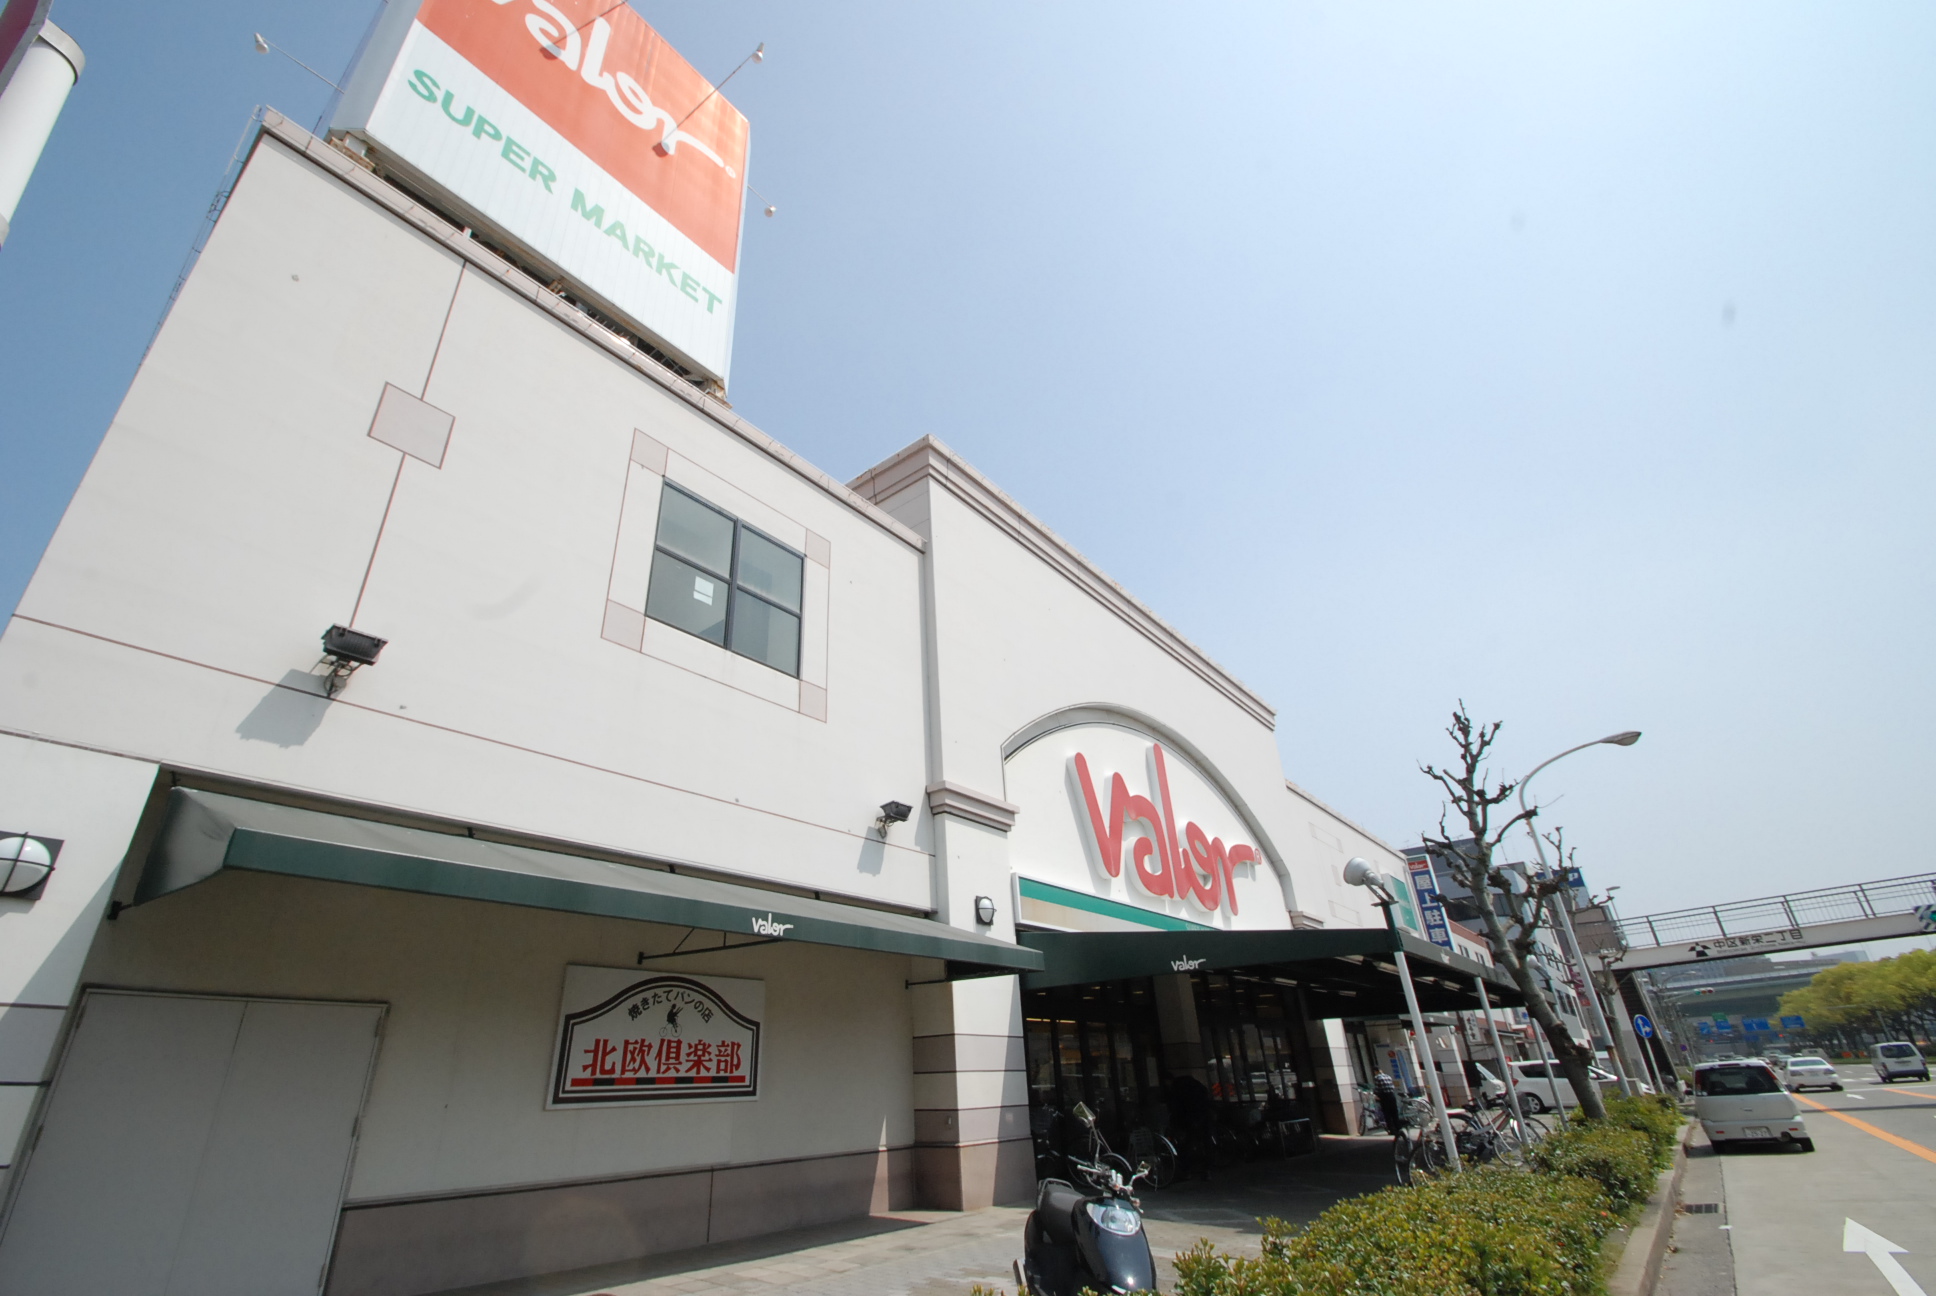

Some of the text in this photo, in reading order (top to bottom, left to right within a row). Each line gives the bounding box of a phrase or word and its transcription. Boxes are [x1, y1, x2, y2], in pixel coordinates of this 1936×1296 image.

[491, 0, 726, 168] alor
[407, 69, 723, 314] SUPER MARKET
[1414, 874, 1450, 951] 屋上駐車
[1713, 928, 1803, 949] 中区新栄二丁目
[627, 989, 714, 1023] 焼きたてパンの店
[582, 1038, 742, 1077] 北欧倶楽部
